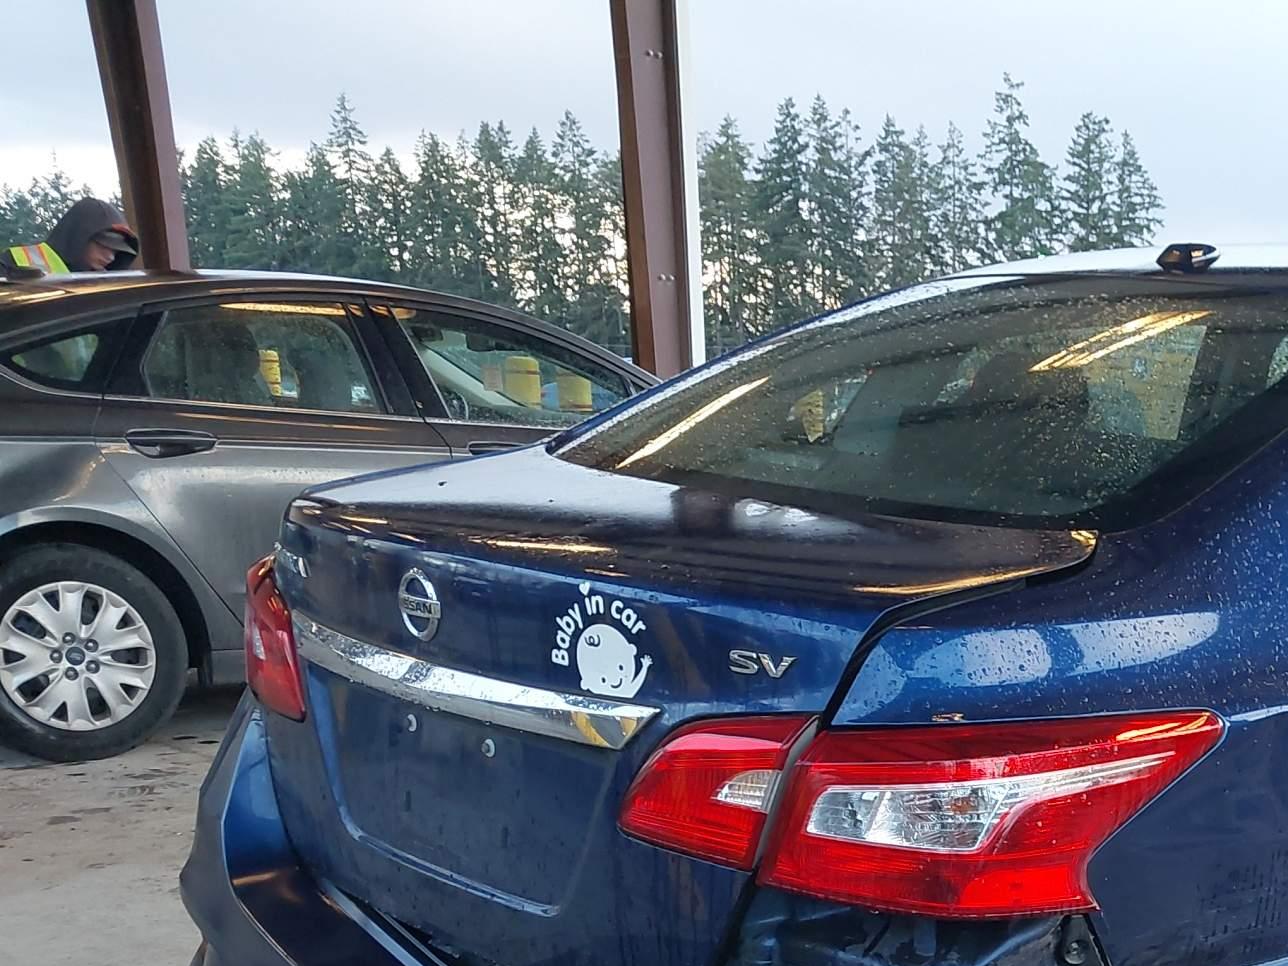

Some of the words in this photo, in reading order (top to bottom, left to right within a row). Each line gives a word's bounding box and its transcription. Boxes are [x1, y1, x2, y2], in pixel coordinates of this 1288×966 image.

[400, 595, 433, 615] SSAN
[551, 603, 584, 667] Baby
[583, 588, 605, 616] in
[610, 600, 647, 634] car
[729, 649, 797, 679] SV
